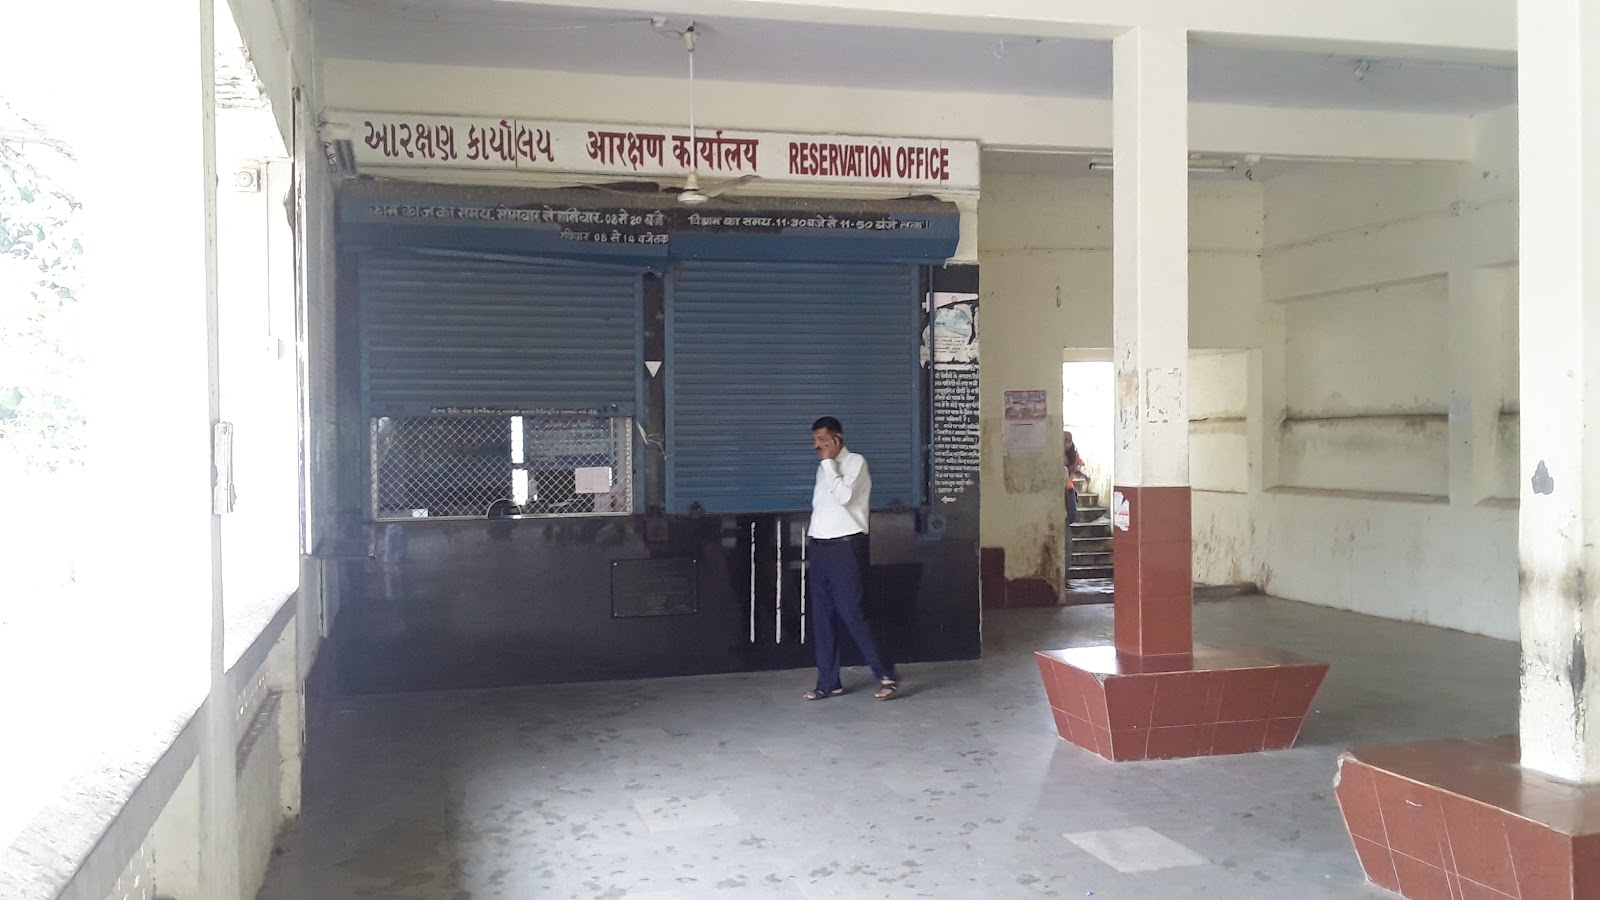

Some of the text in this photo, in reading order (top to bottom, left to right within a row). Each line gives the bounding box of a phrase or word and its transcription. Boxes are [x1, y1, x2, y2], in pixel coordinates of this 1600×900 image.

[364, 120, 458, 161] આરક્ષણ
[586, 130, 759, 173] आरक्षण कार्यालय
[789, 142, 949, 180] RESERVATION OFFICE
[610, 229, 622, 244] से
[623, 233, 636, 243] 14
[630, 215, 643, 226] 20
